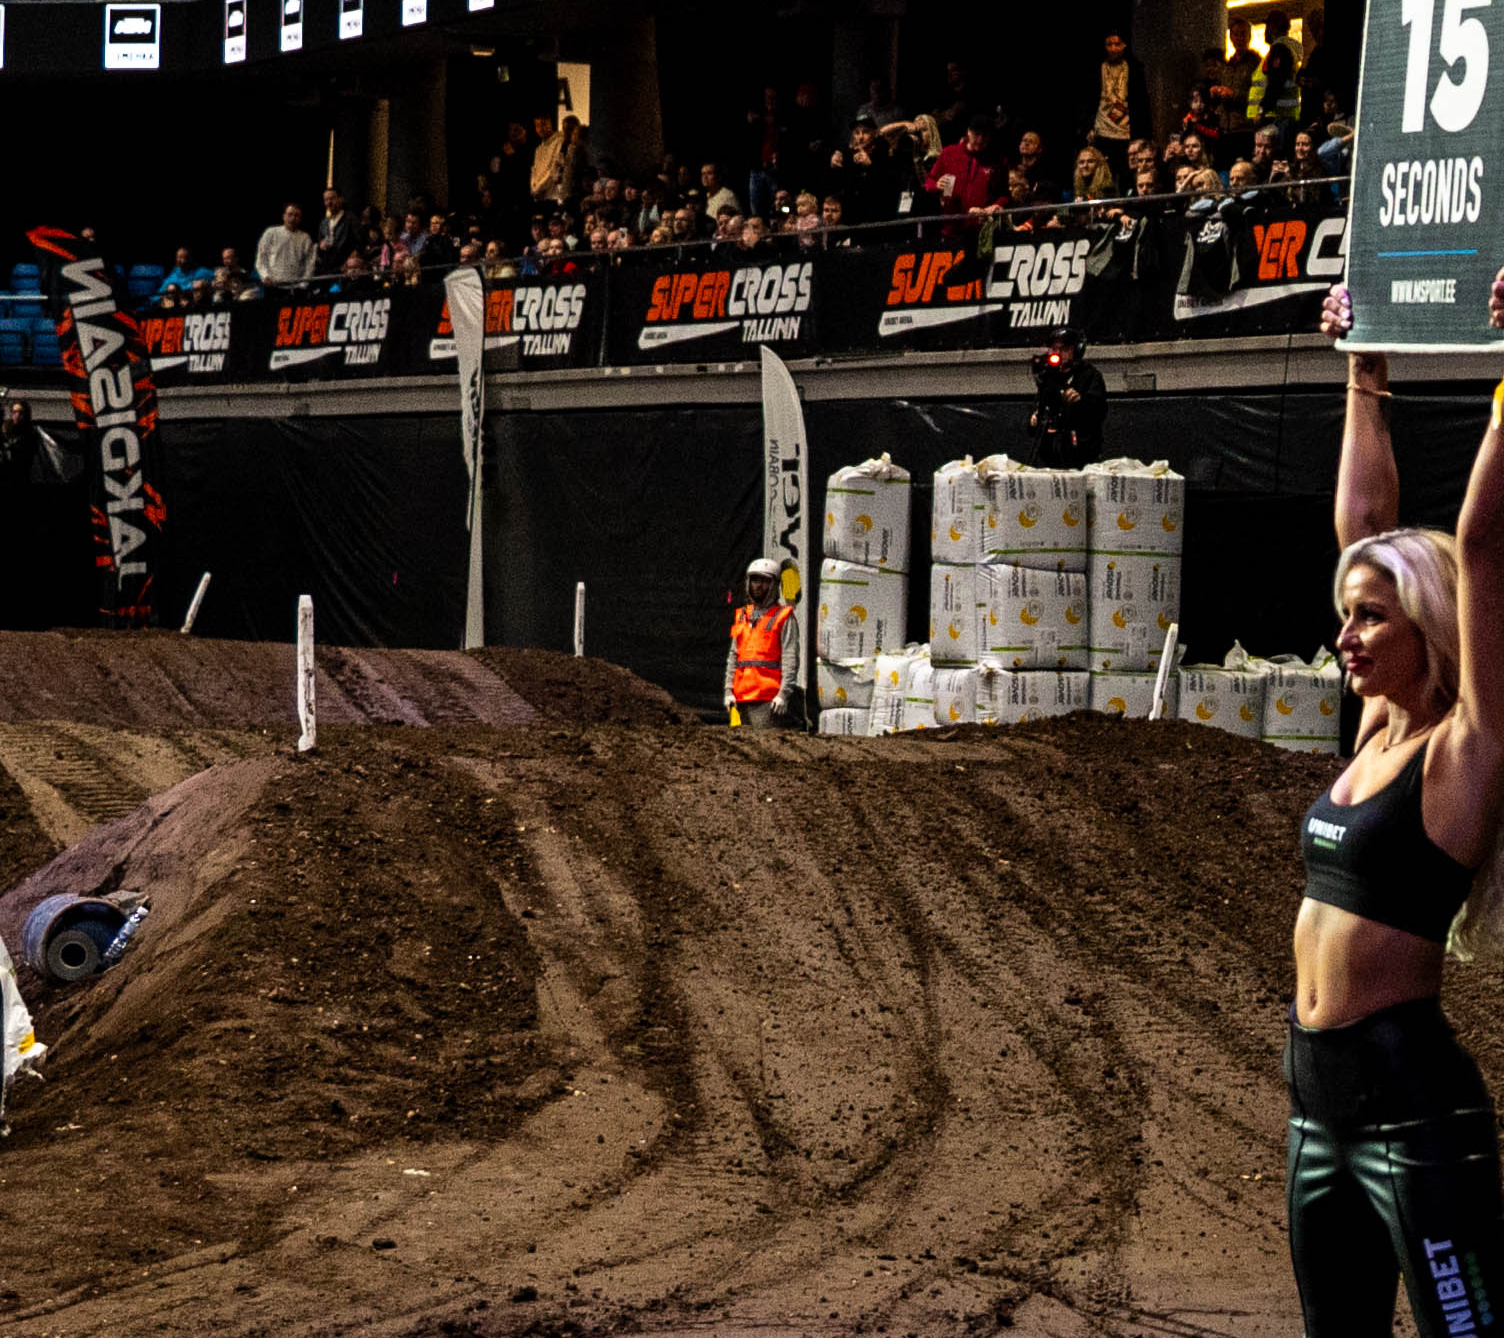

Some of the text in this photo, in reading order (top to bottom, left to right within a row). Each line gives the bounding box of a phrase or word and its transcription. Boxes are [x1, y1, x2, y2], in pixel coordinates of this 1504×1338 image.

[1378, 156, 1484, 227] SECONDS
[646, 262, 814, 322] SUPER CROSS
[986, 238, 1091, 298] CROSS
[275, 298, 391, 347] SUPER CROSS
[512, 284, 587, 333] CROSS
[742, 316, 801, 343] TALLINN
[1009, 299, 1070, 328] TALLINN
[1307, 815, 1348, 844] UNIBET
